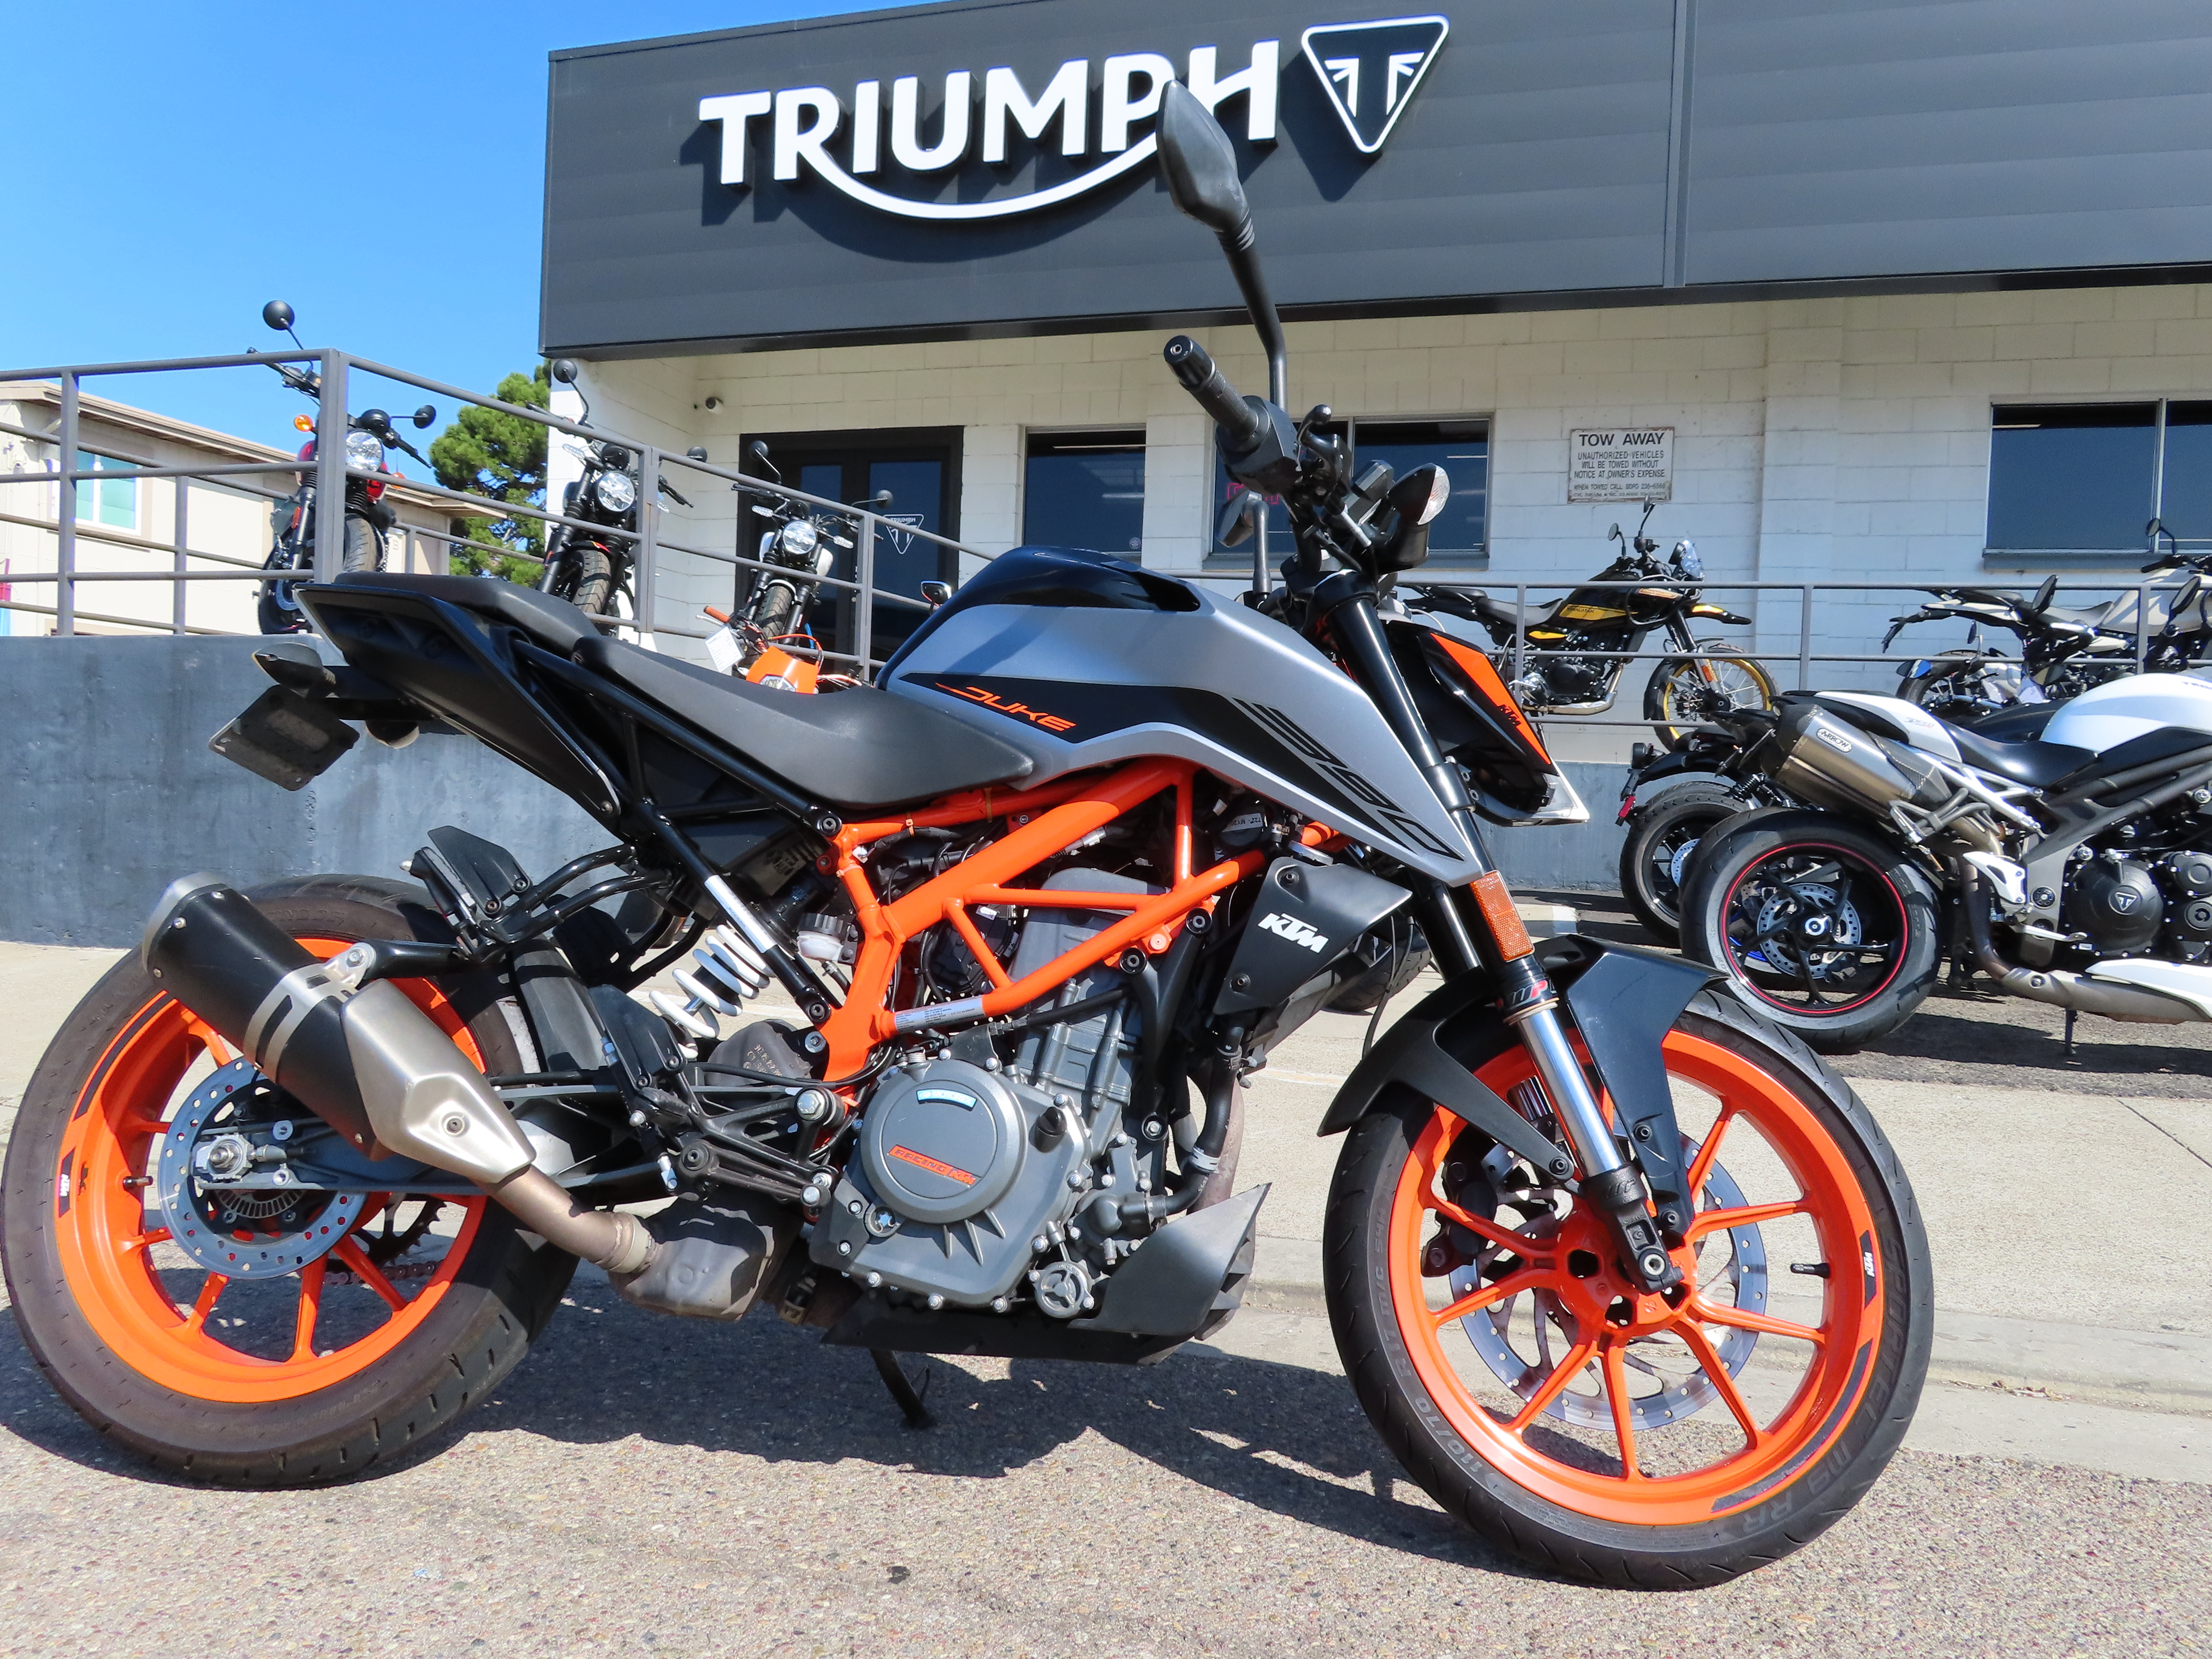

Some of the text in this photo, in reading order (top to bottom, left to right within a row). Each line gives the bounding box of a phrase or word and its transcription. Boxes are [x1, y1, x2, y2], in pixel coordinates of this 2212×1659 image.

[699, 39, 1280, 219] TRIUMPH
[1579, 432, 1665, 446] TOW AWAY
[1578, 450, 1664, 460] UNAUTHORIZED VEHICLES
[1581, 460, 1659, 469] WILL BE TOWED WITHOUT
[1574, 470, 1596, 478] NOTICE
[1607, 470, 1635, 478] OWNER'S
[1637, 469, 1665, 477] EXPENSE
[935, 682, 1076, 731] DUKE
[1498, 704, 1522, 727] KTM
[1820, 730, 1850, 748] ARROW
[1231, 697, 1467, 862] 390
[1257, 912, 1329, 954] KTM
[931, 1090, 973, 1105] MOTOREX
[1863, 1251, 1875, 1278] KTM
[1415, 1396, 1483, 1473] 110/70
